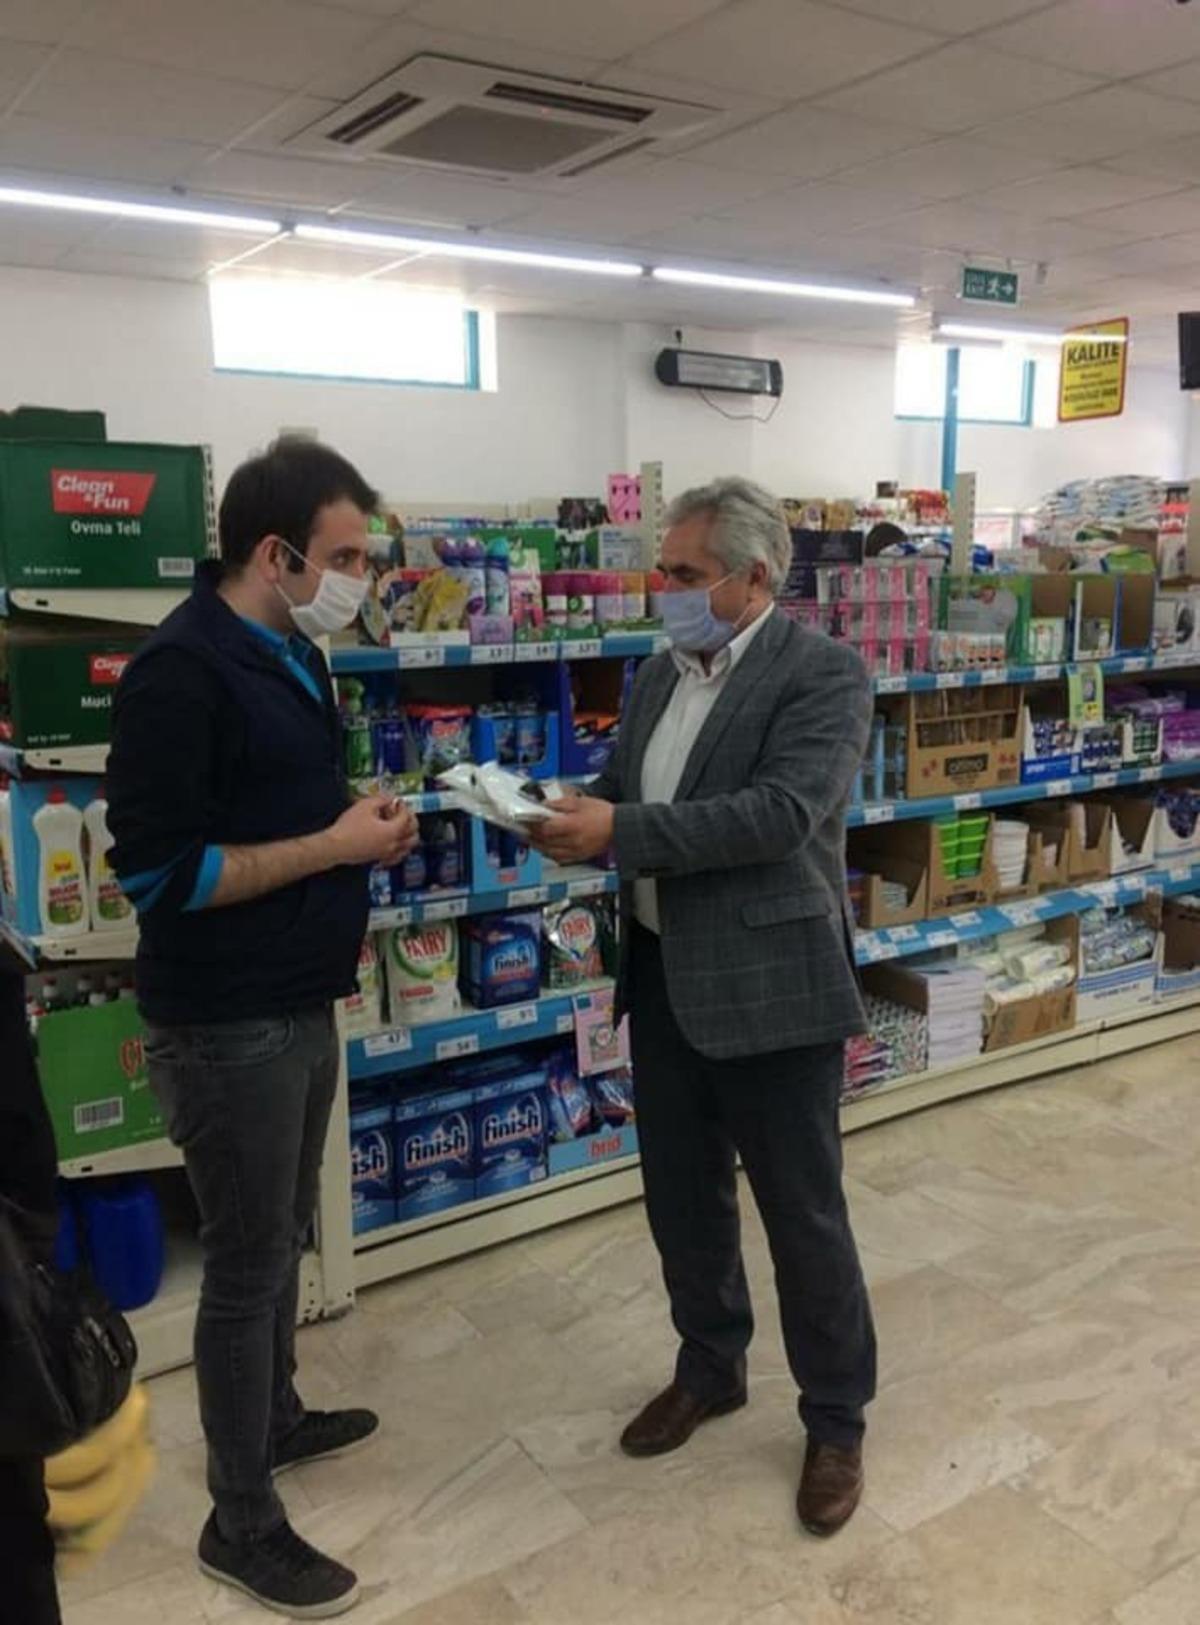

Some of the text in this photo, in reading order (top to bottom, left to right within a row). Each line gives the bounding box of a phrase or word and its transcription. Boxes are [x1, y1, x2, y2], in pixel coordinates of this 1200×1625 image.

[58, 475, 114, 494] Clean
[93, 493, 130, 510] Fun
[71, 520, 141, 535] Ovma Teli
[483, 1109, 541, 1143] finish
[406, 1127, 466, 1164] finish
